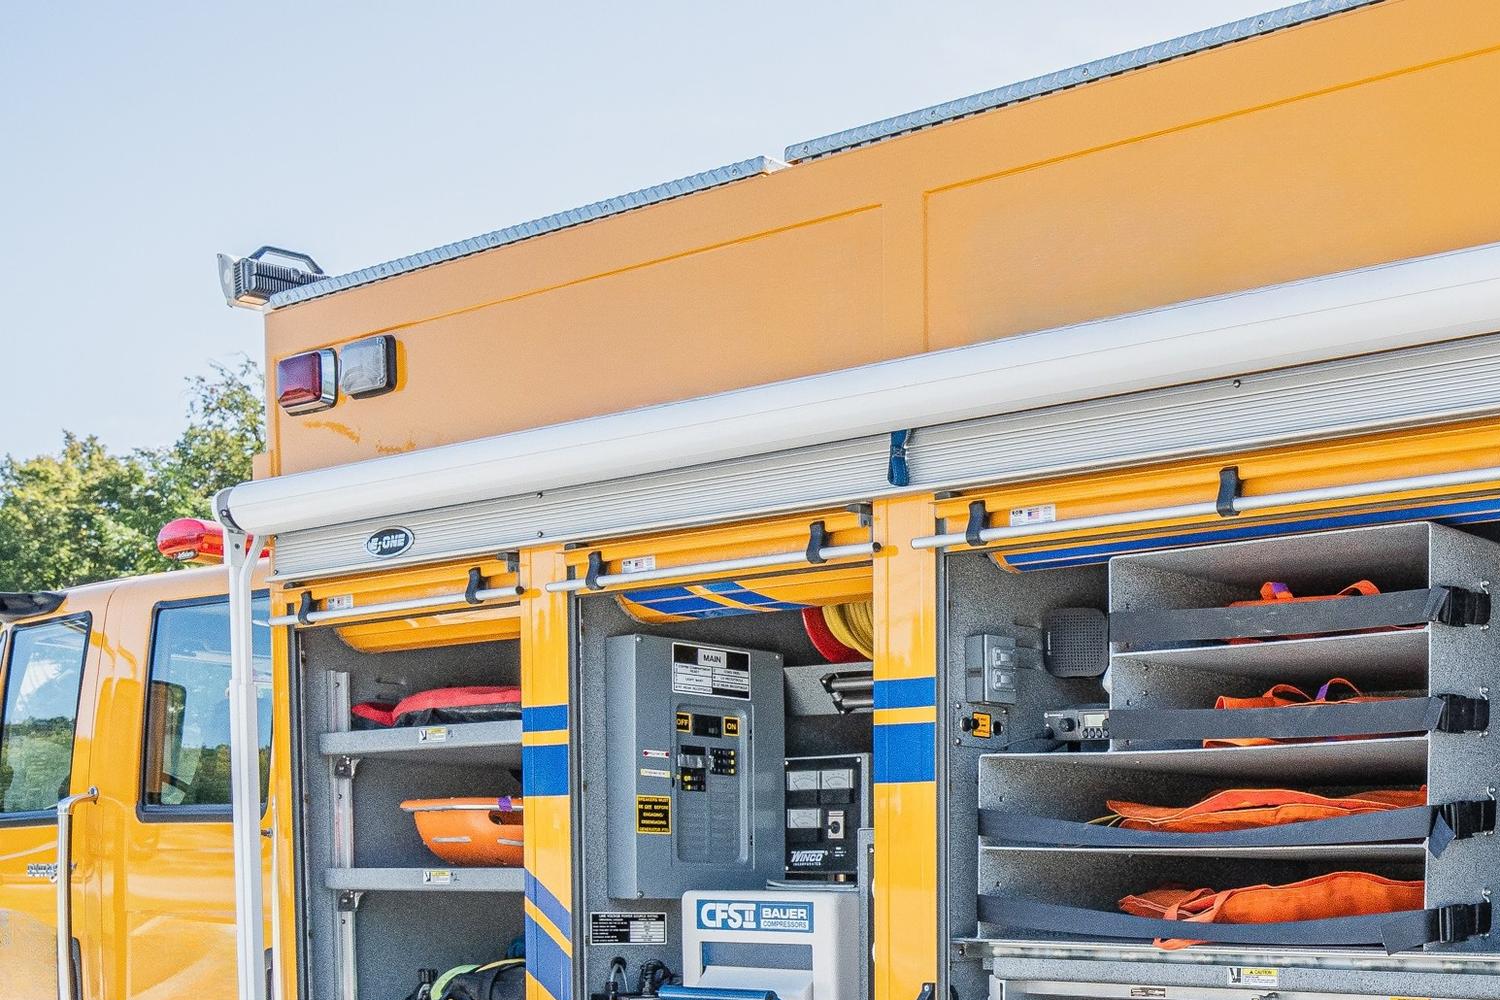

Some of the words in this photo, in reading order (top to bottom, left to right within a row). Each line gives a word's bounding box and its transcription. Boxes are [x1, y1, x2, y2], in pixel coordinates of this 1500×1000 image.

[703, 654, 722, 664] MAIN
[676, 719, 688, 728] OFF
[791, 850, 824, 862] WINCO
[762, 908, 807, 920] BAUER
[763, 920, 807, 928] COMPRESSORS
